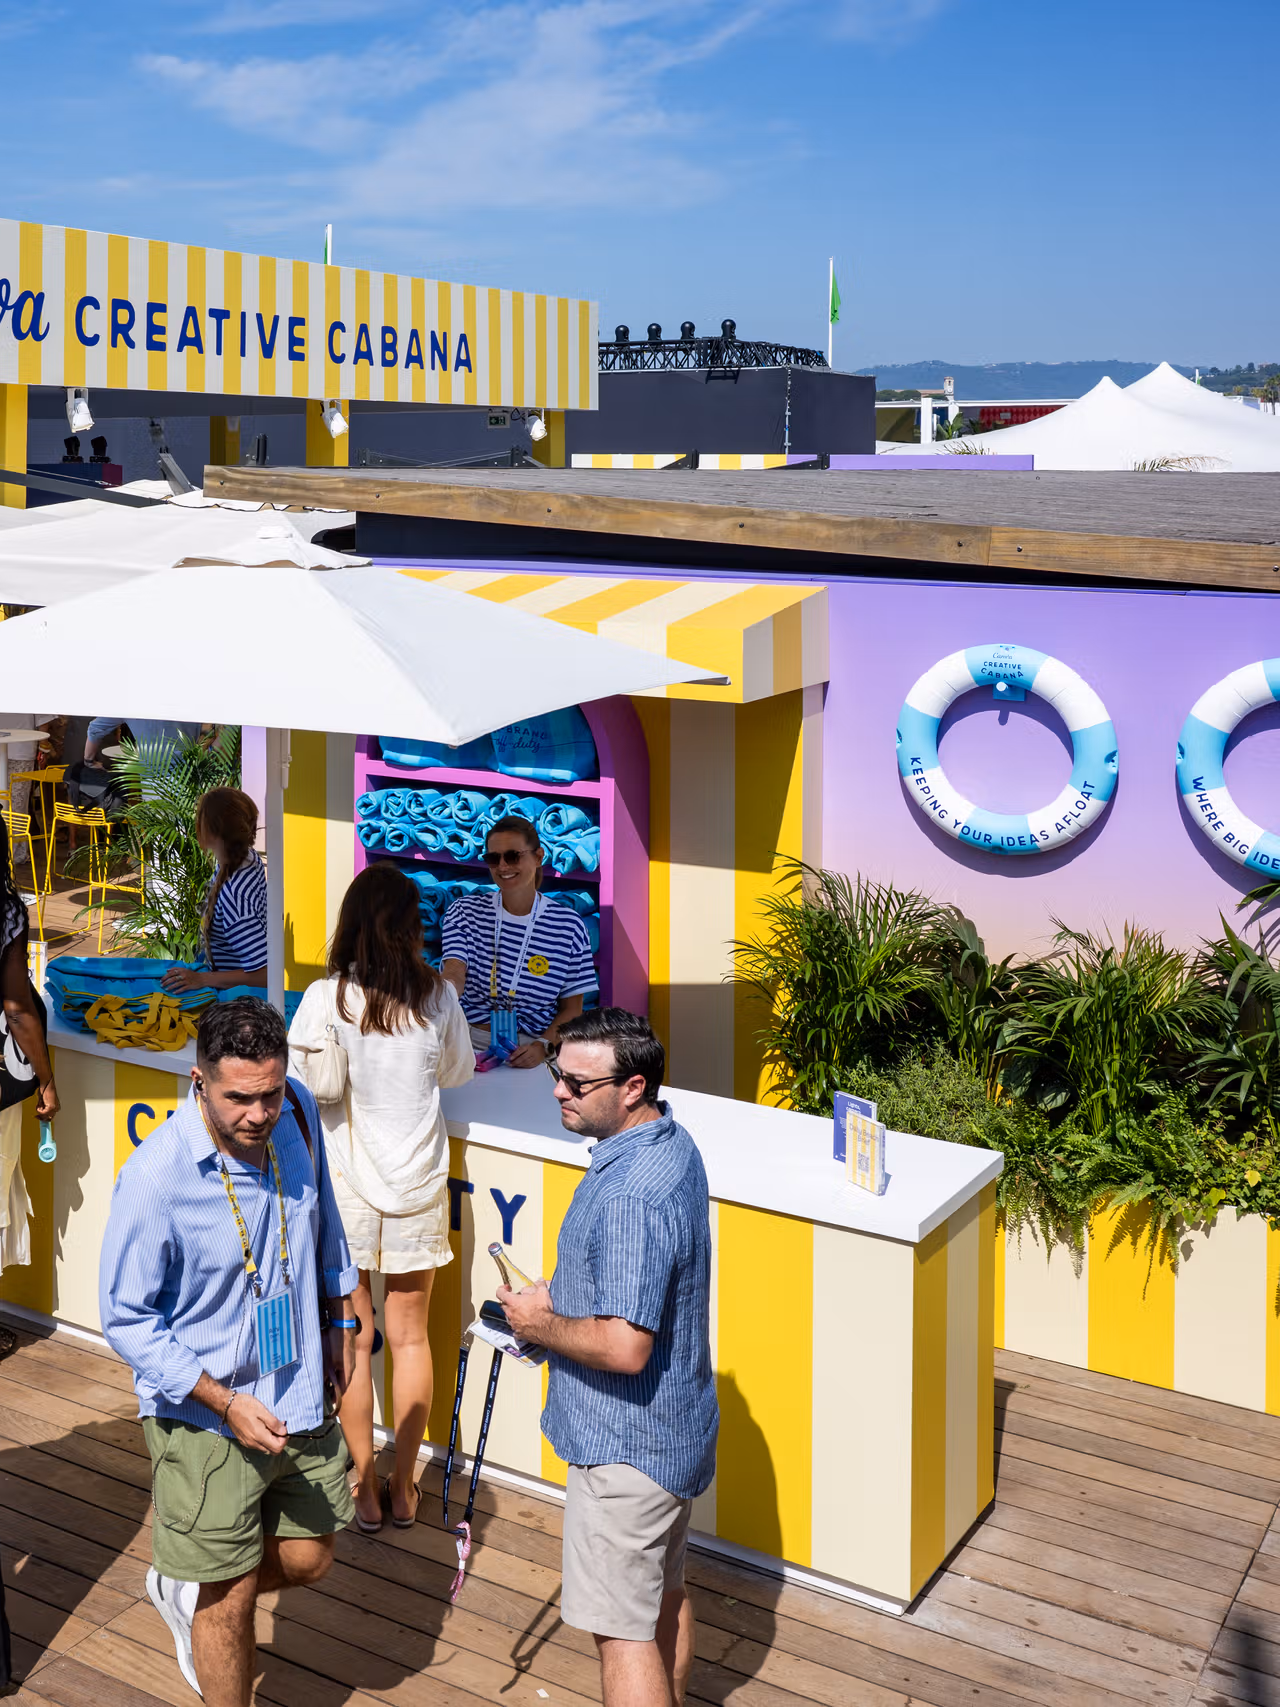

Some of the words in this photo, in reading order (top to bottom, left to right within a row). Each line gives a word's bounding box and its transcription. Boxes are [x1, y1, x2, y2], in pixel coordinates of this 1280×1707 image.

[75, 295, 306, 362] CREATIVE
[328, 320, 473, 373] CABANA
[980, 667, 1024, 679] CABANA
[983, 661, 1022, 670] CREATIVE
[910, 756, 948, 819] KEEPING
[952, 819, 993, 845] YOUR
[1000, 830, 1050, 847] IDEAS
[1054, 780, 1095, 834] AFLOAT
[1192, 775, 1225, 832] WHERE
[1223, 832, 1249, 855] BIG
